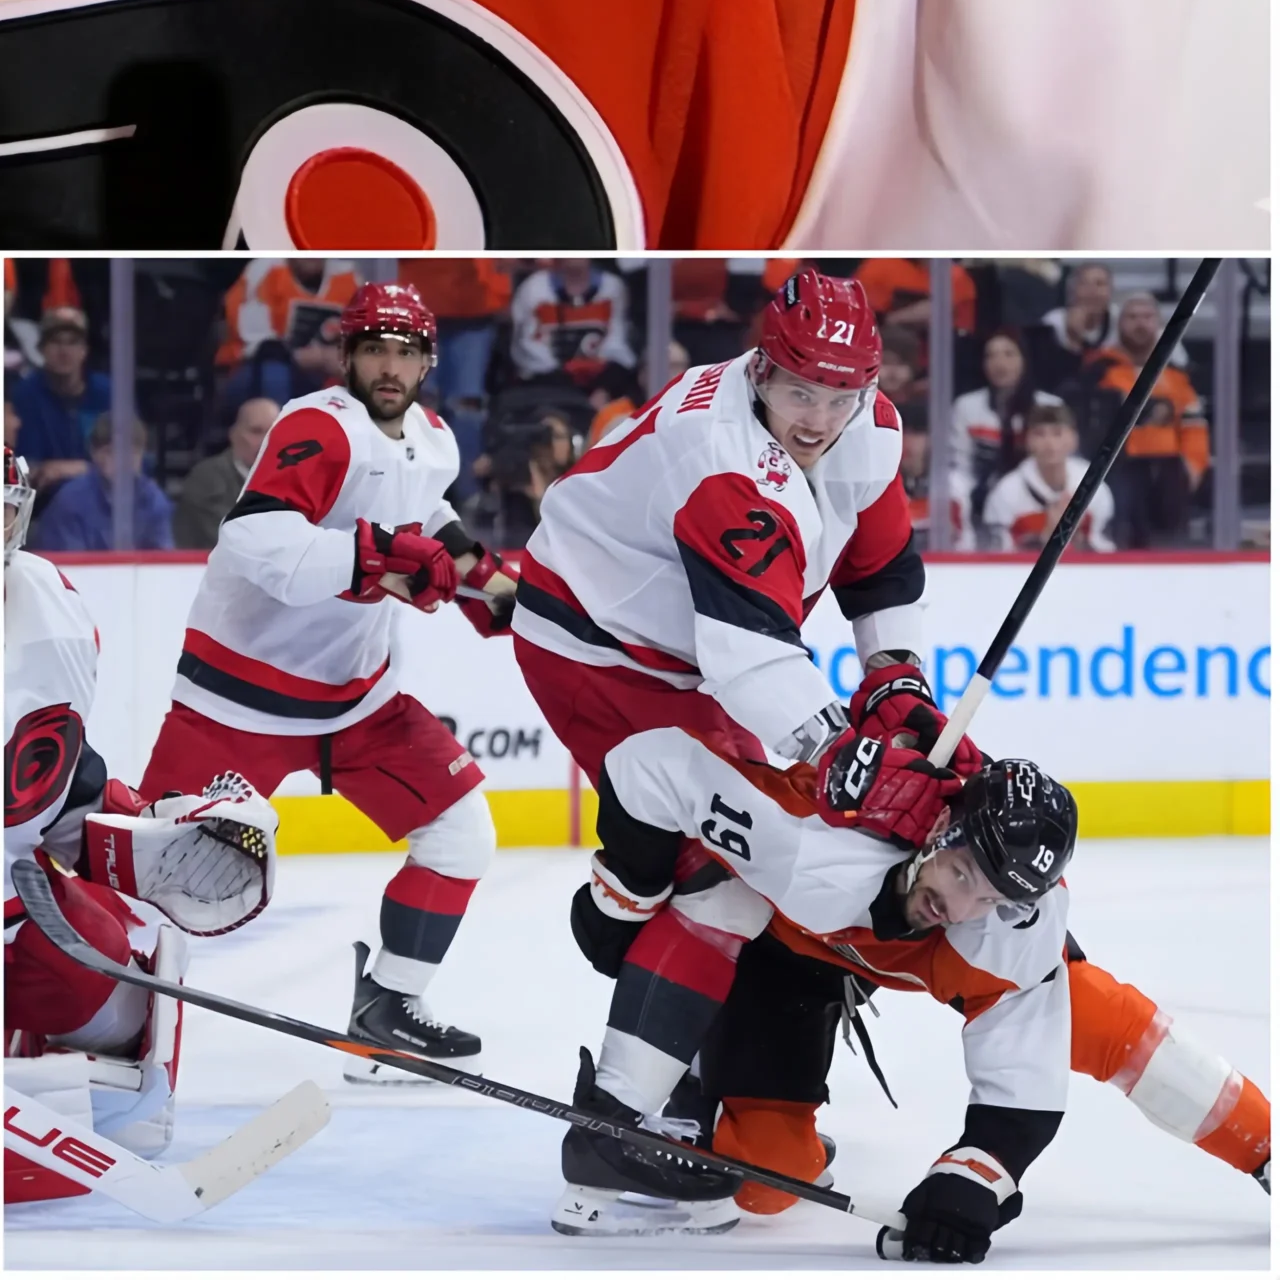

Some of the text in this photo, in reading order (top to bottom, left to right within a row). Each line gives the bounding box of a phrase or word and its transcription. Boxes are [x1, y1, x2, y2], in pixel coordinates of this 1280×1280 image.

[719, 508, 791, 578] 21
[844, 736, 882, 801] CC
[700, 792, 754, 862] 19
[1031, 844, 1055, 873] 19
